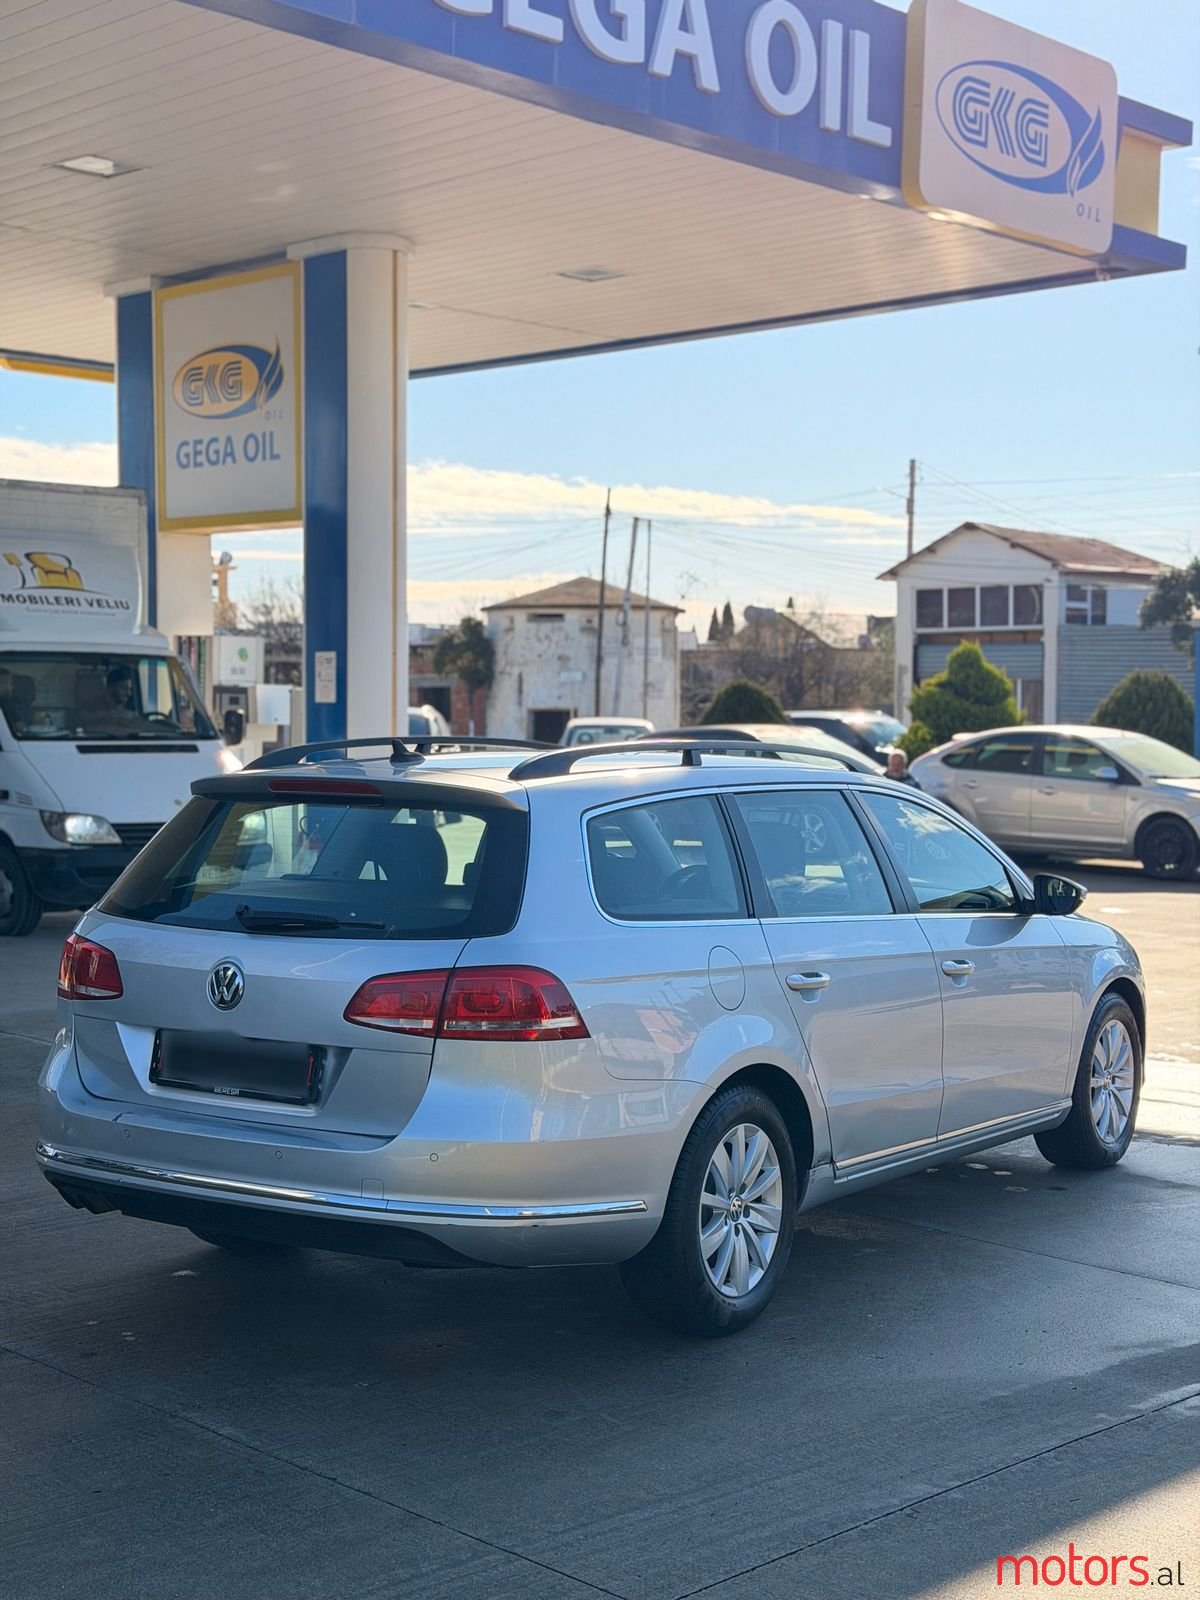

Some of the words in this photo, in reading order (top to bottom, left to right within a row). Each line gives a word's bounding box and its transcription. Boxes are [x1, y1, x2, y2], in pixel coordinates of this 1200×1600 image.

[433, 0, 720, 94] GA
[745, 0, 893, 148] OIL
[952, 75, 1049, 168] GKG
[1076, 203, 1101, 223] OIL
[182, 360, 243, 407] GKG
[265, 410, 284, 421] OIL
[175, 435, 237, 469] GEGA
[243, 431, 281, 463] OIL
[0, 593, 82, 607] MOBILERI
[84, 597, 130, 611] VELIU
